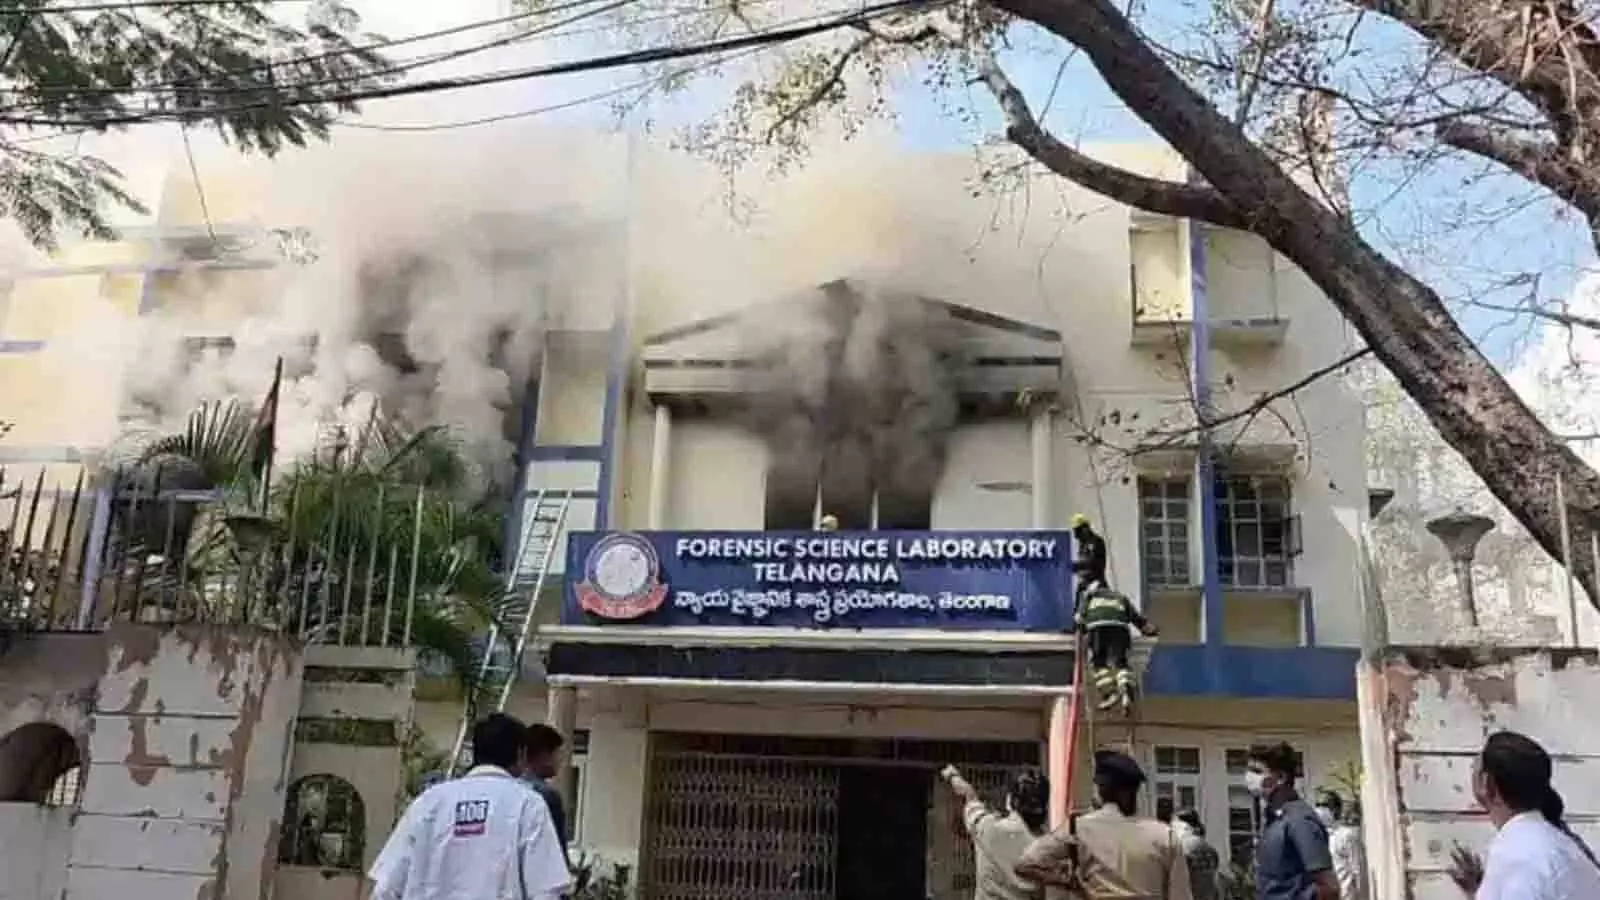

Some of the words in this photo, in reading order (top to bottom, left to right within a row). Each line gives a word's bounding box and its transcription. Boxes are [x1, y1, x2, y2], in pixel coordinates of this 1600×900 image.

[676, 539, 788, 557] FORENSIC
[794, 539, 888, 557] SCIENCE
[896, 539, 1056, 558] LABORATORY
[752, 563, 899, 583] TELANGANA
